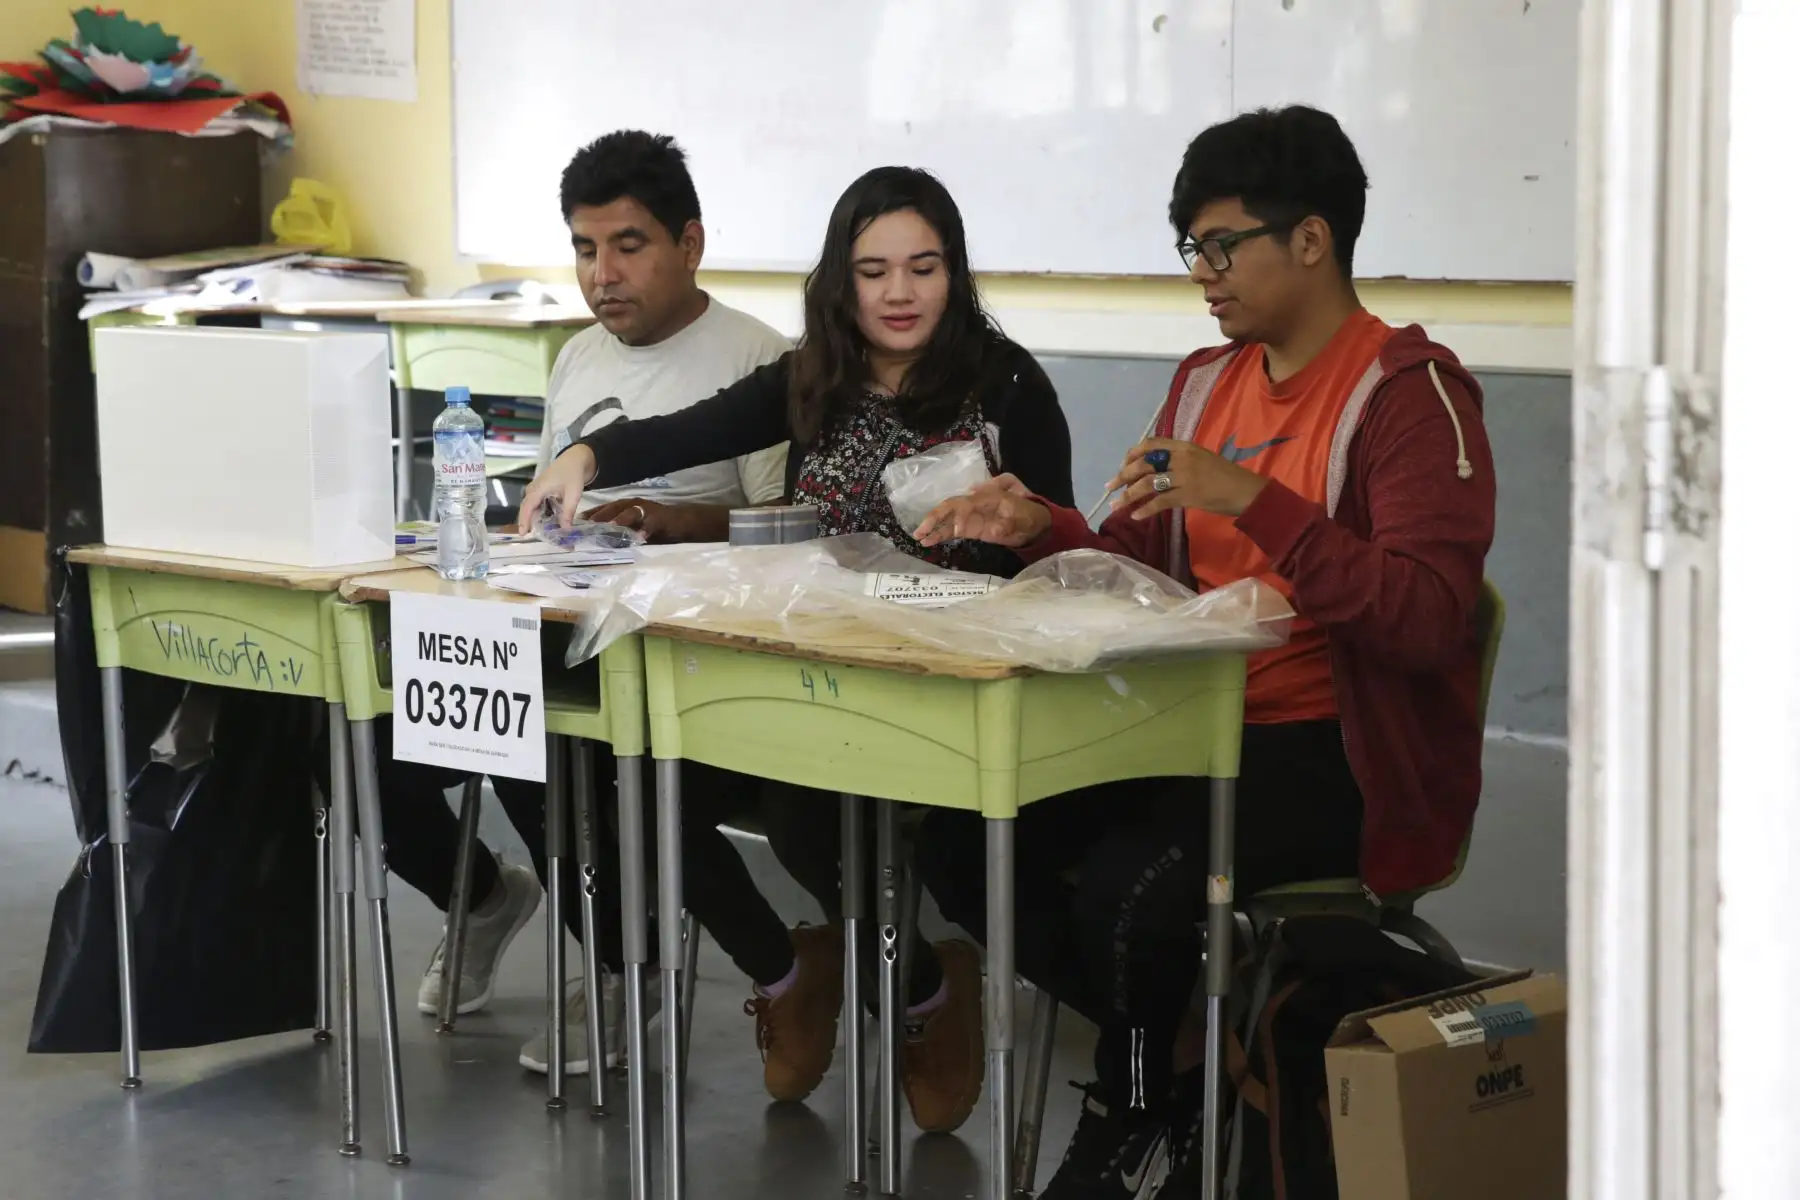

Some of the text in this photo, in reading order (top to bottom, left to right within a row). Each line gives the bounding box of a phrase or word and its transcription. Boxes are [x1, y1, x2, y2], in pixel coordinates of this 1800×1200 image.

[442, 463, 463, 474] San
[880, 592, 944, 600] ELECTORALES
[418, 631, 487, 668] MESA
[405, 678, 532, 739] 033707
[1475, 1063, 1524, 1098] ONPE
